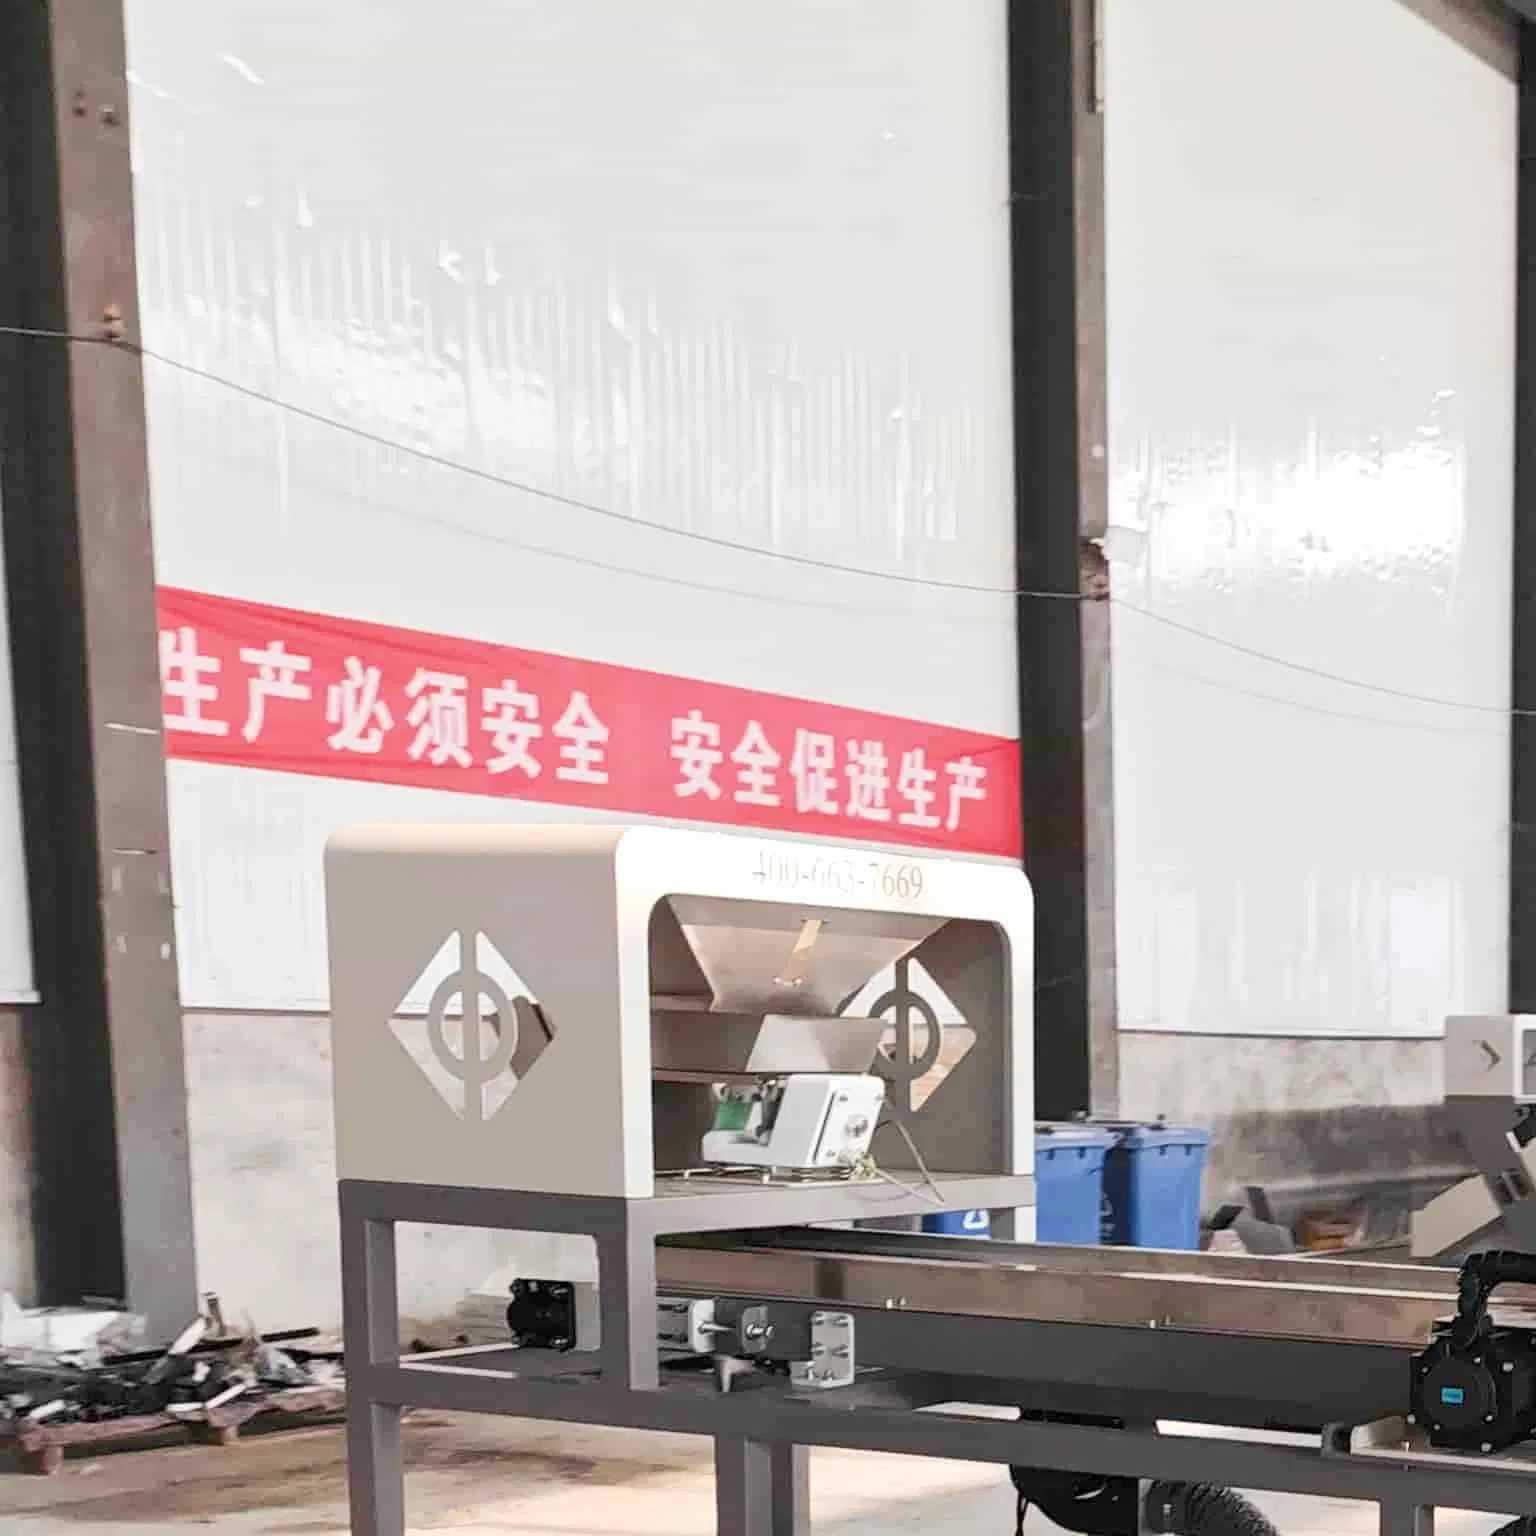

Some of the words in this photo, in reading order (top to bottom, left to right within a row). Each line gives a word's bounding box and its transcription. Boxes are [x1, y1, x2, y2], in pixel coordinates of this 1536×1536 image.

[159, 627, 609, 785] 生产必须安全
[669, 709, 987, 832] 安全促进生产
